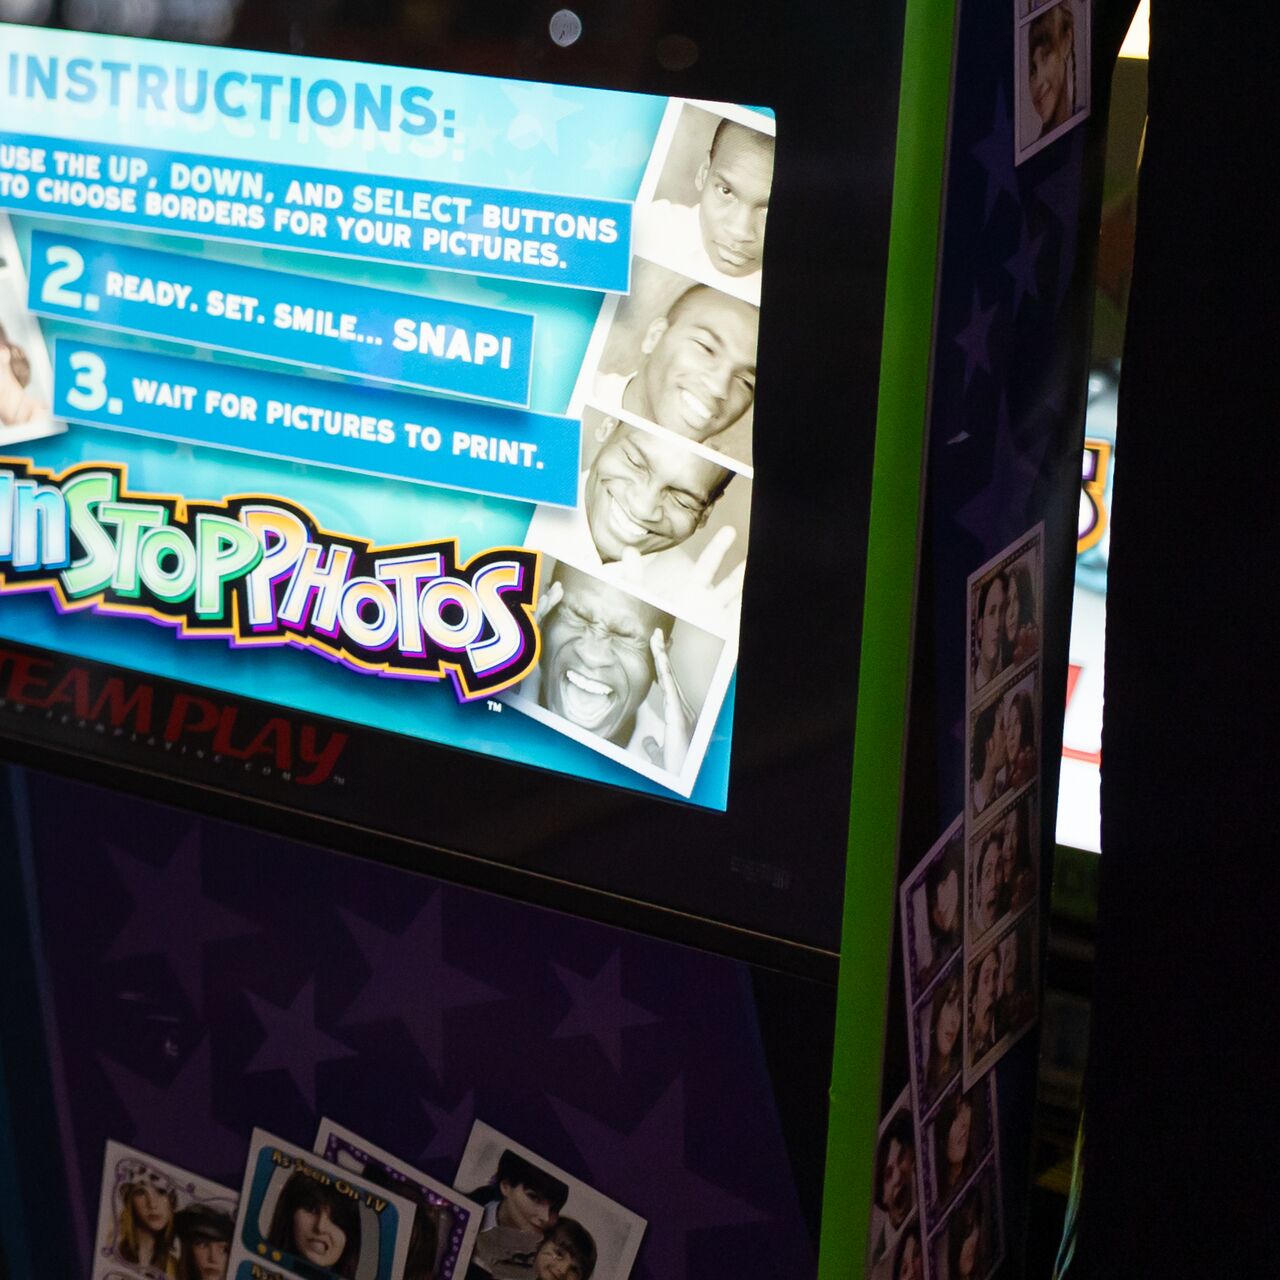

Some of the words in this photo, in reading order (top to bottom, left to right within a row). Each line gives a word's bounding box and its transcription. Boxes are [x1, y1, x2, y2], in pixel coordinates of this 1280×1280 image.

[8, 52, 456, 138] INSTRUCTIONS:
[35, 175, 137, 214] CHOOSE
[144, 192, 266, 230] BORDERS
[273, 208, 328, 239] FOR
[336, 216, 412, 249] YOUR
[422, 227, 568, 270] PICTURES.
[52, 151, 102, 180] THE
[108, 154, 158, 188] UP,
[170, 162, 274, 204] DOWN,
[285, 179, 344, 210] AND
[352, 185, 472, 226] SELECT
[482, 204, 619, 245] BUTTONS
[40, 245, 101, 312] 2.
[105, 271, 199, 313] READY.
[205, 290, 266, 325] SET.
[272, 302, 384, 346] SMILE...
[66, 350, 124, 416] 3.
[131, 377, 198, 412] WAIT
[204, 391, 257, 422] FOR
[265, 401, 396, 446] PICTURES
[403, 423, 442, 453] TO
[451, 431, 545, 471] PRINT.
[162, 693, 350, 786] PLAY
[334, 1179, 360, 1202] On
[365, 1193, 388, 1215] TV
